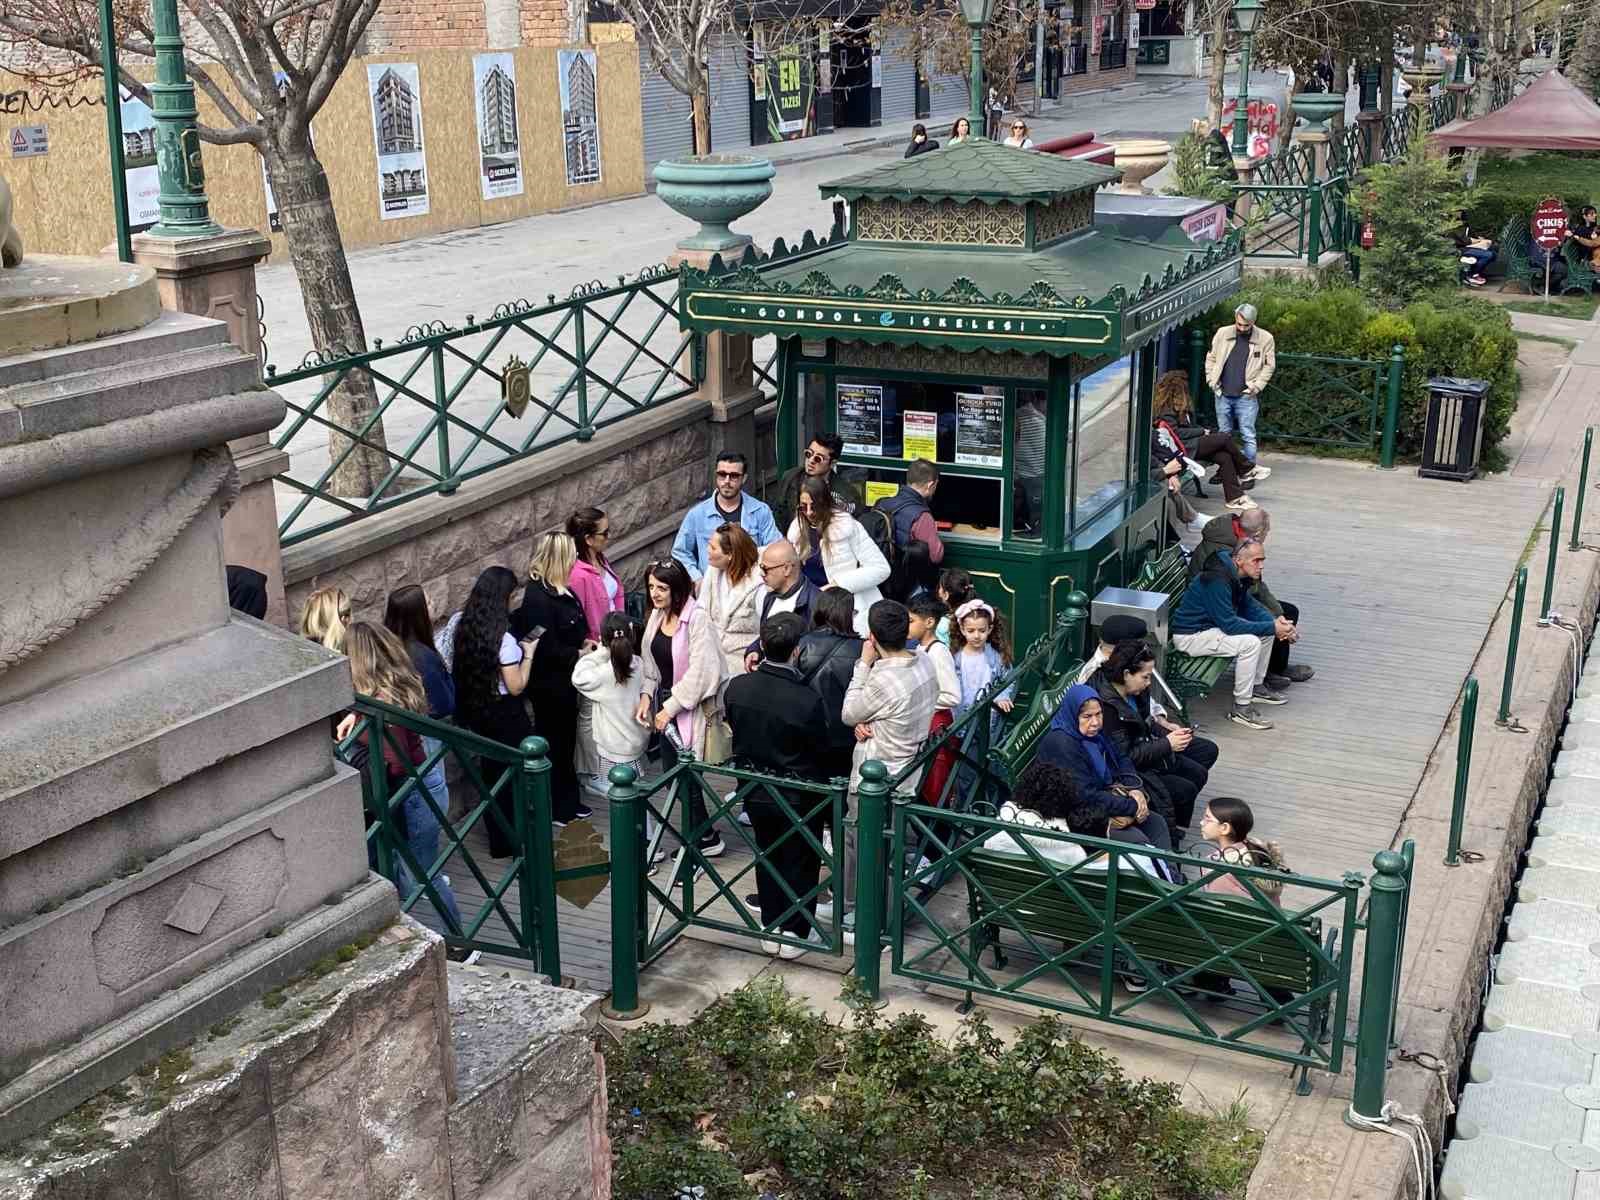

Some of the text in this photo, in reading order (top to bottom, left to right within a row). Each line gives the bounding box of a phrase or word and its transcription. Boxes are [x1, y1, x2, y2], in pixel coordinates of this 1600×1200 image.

[779, 60, 800, 92] EN
[758, 306, 1025, 332] GONDOL İSKELESİ
